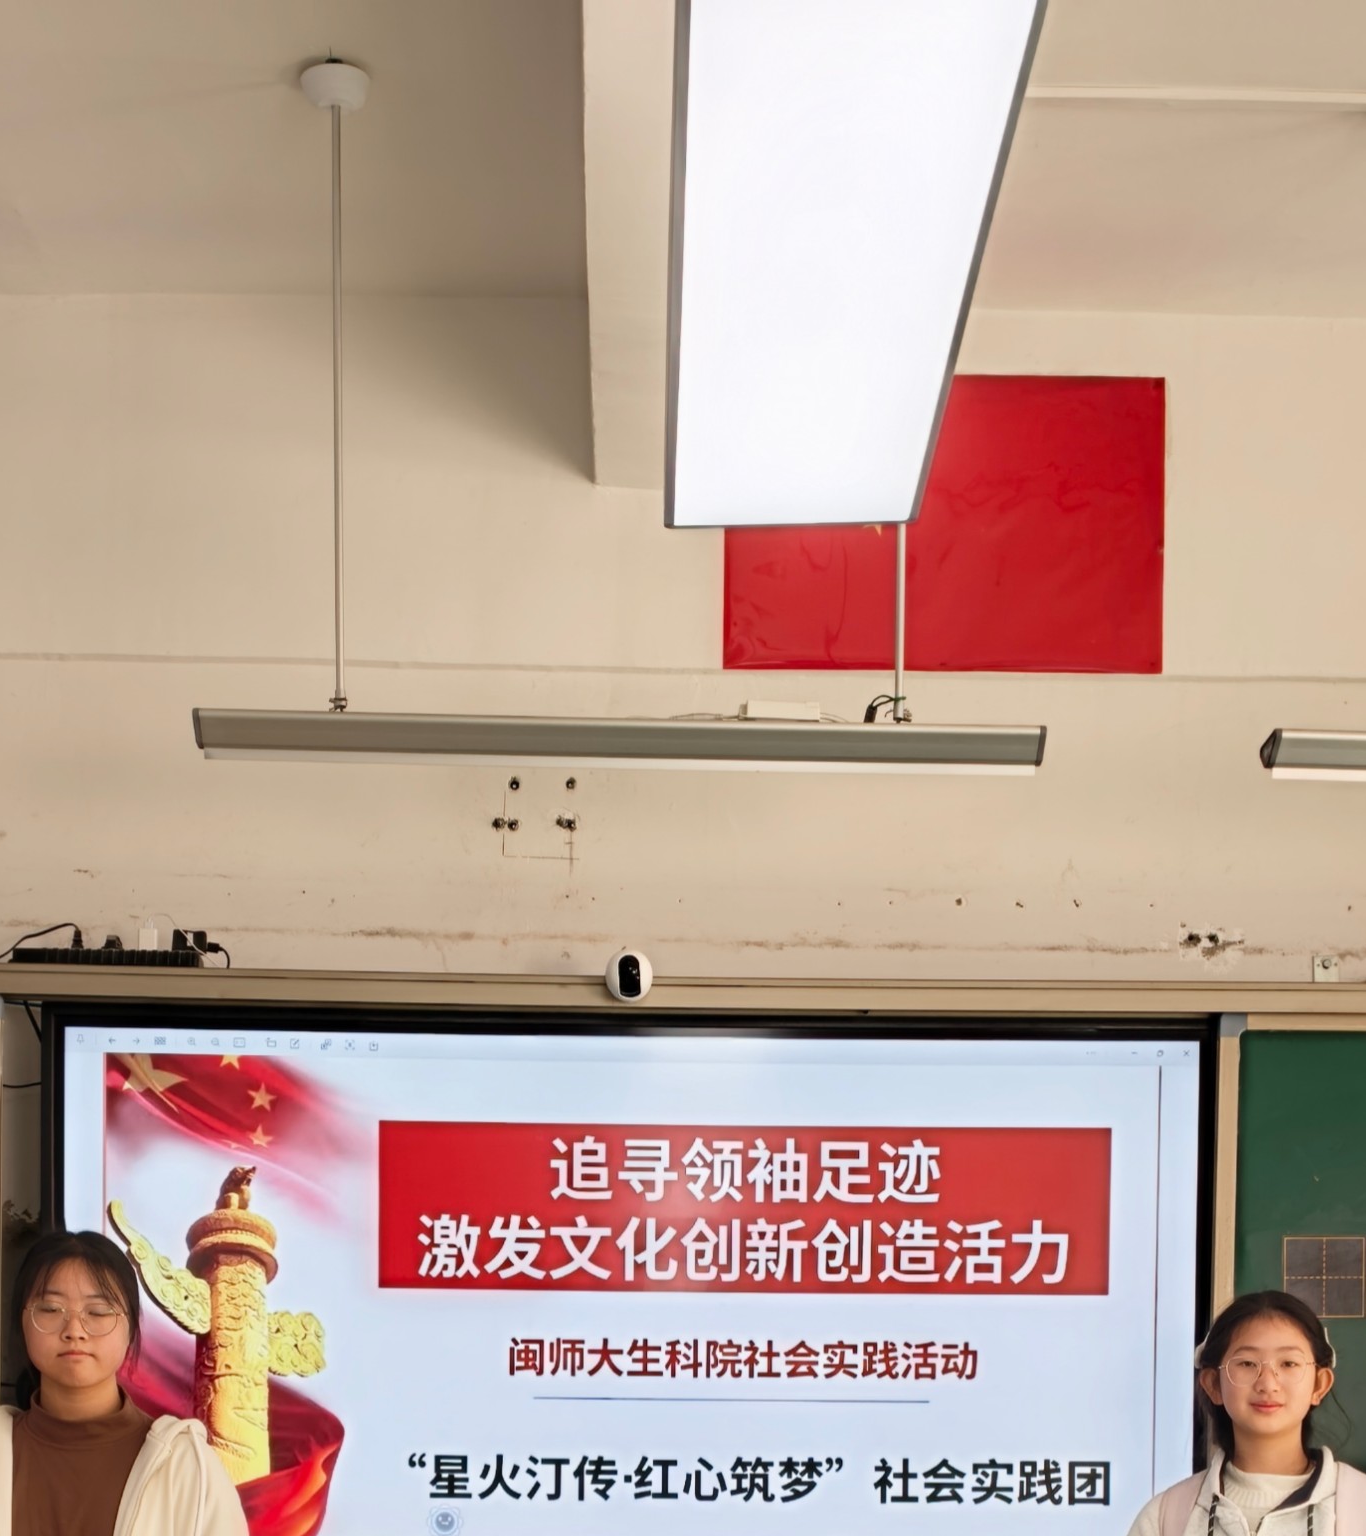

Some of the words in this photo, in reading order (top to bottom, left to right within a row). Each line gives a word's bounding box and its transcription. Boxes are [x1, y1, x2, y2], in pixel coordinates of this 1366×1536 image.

[550, 1135, 941, 1204] 追寻领袖足迹
[417, 1213, 1070, 1285] 激发文化创新创造活力
[507, 1336, 978, 1381] 闽师大生科院社会实践活动
